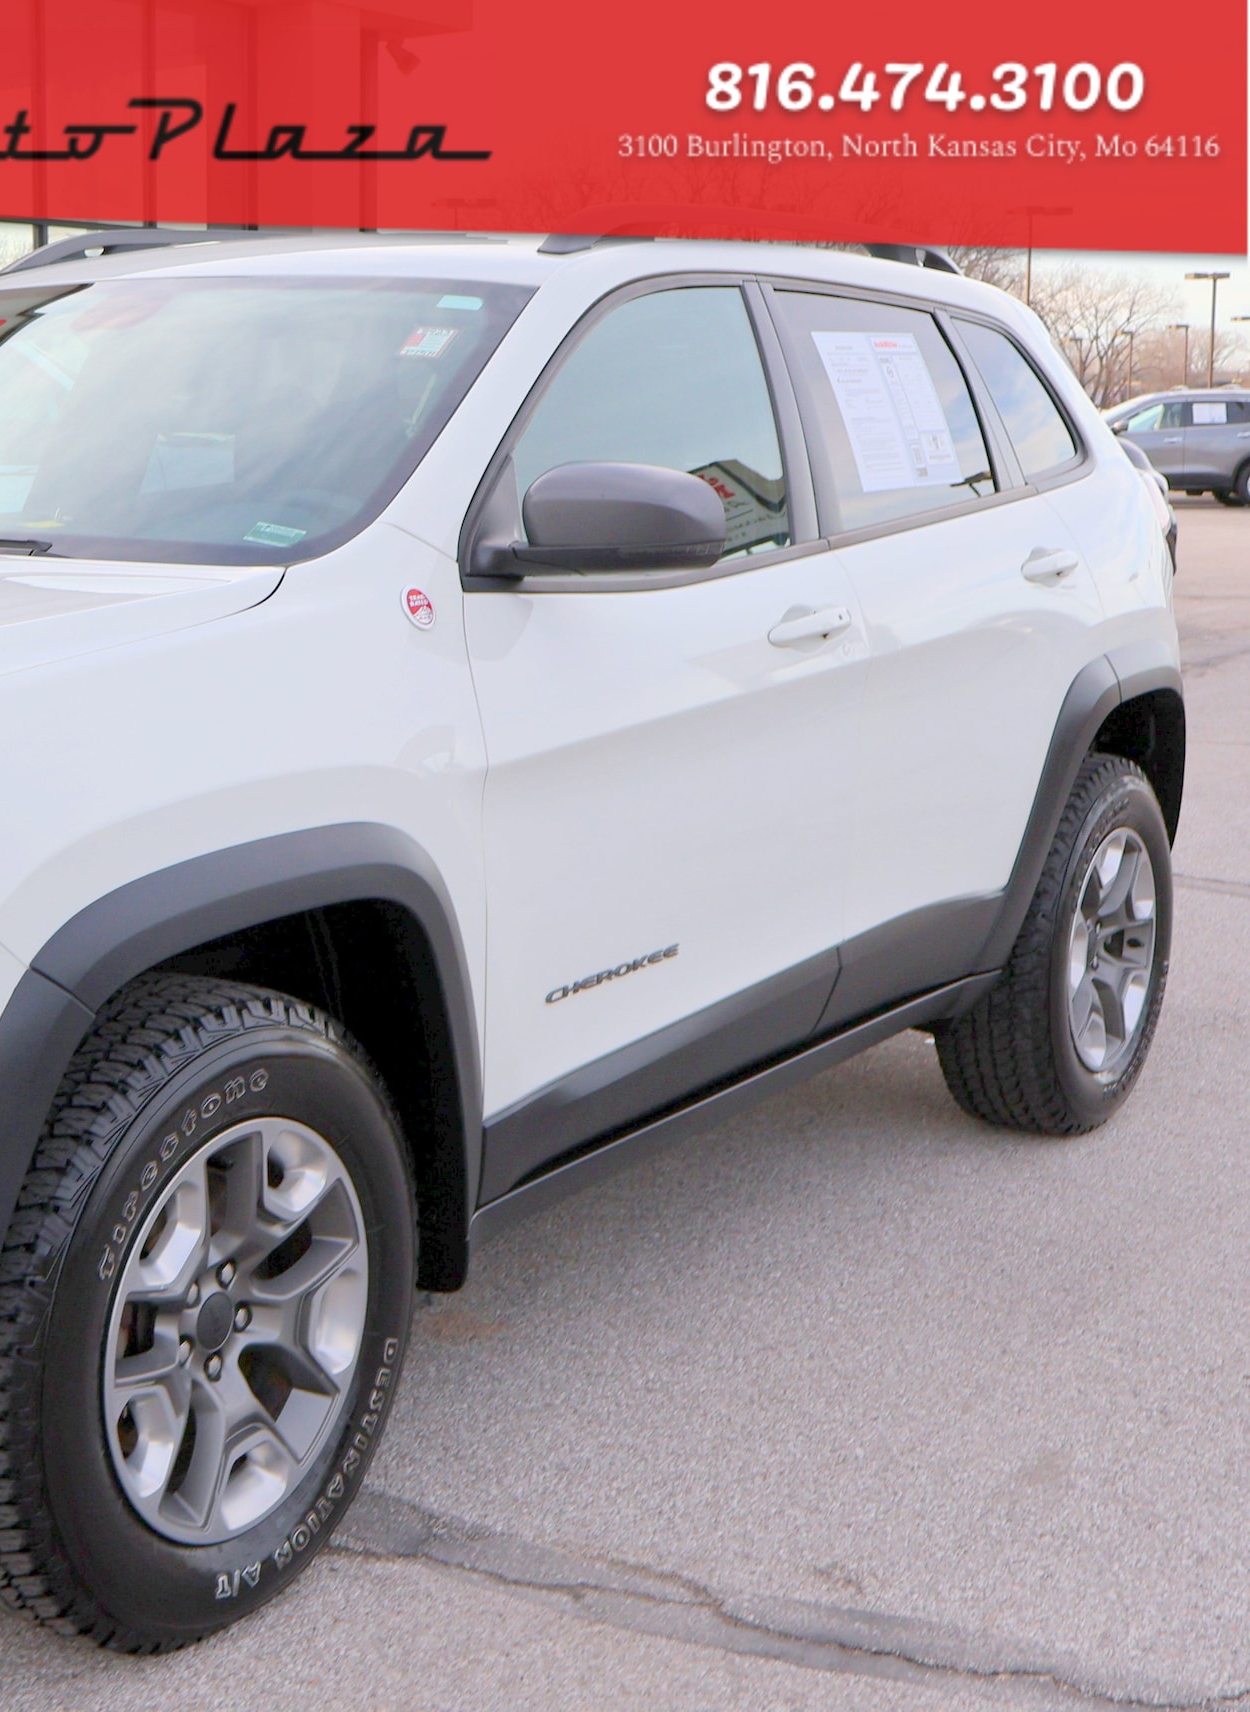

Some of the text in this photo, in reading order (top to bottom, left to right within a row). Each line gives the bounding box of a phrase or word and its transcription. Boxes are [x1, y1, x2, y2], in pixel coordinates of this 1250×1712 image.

[545, 943, 680, 1004] CHEROKEE
[214, 1337, 399, 1600] DESTINATION A/T
